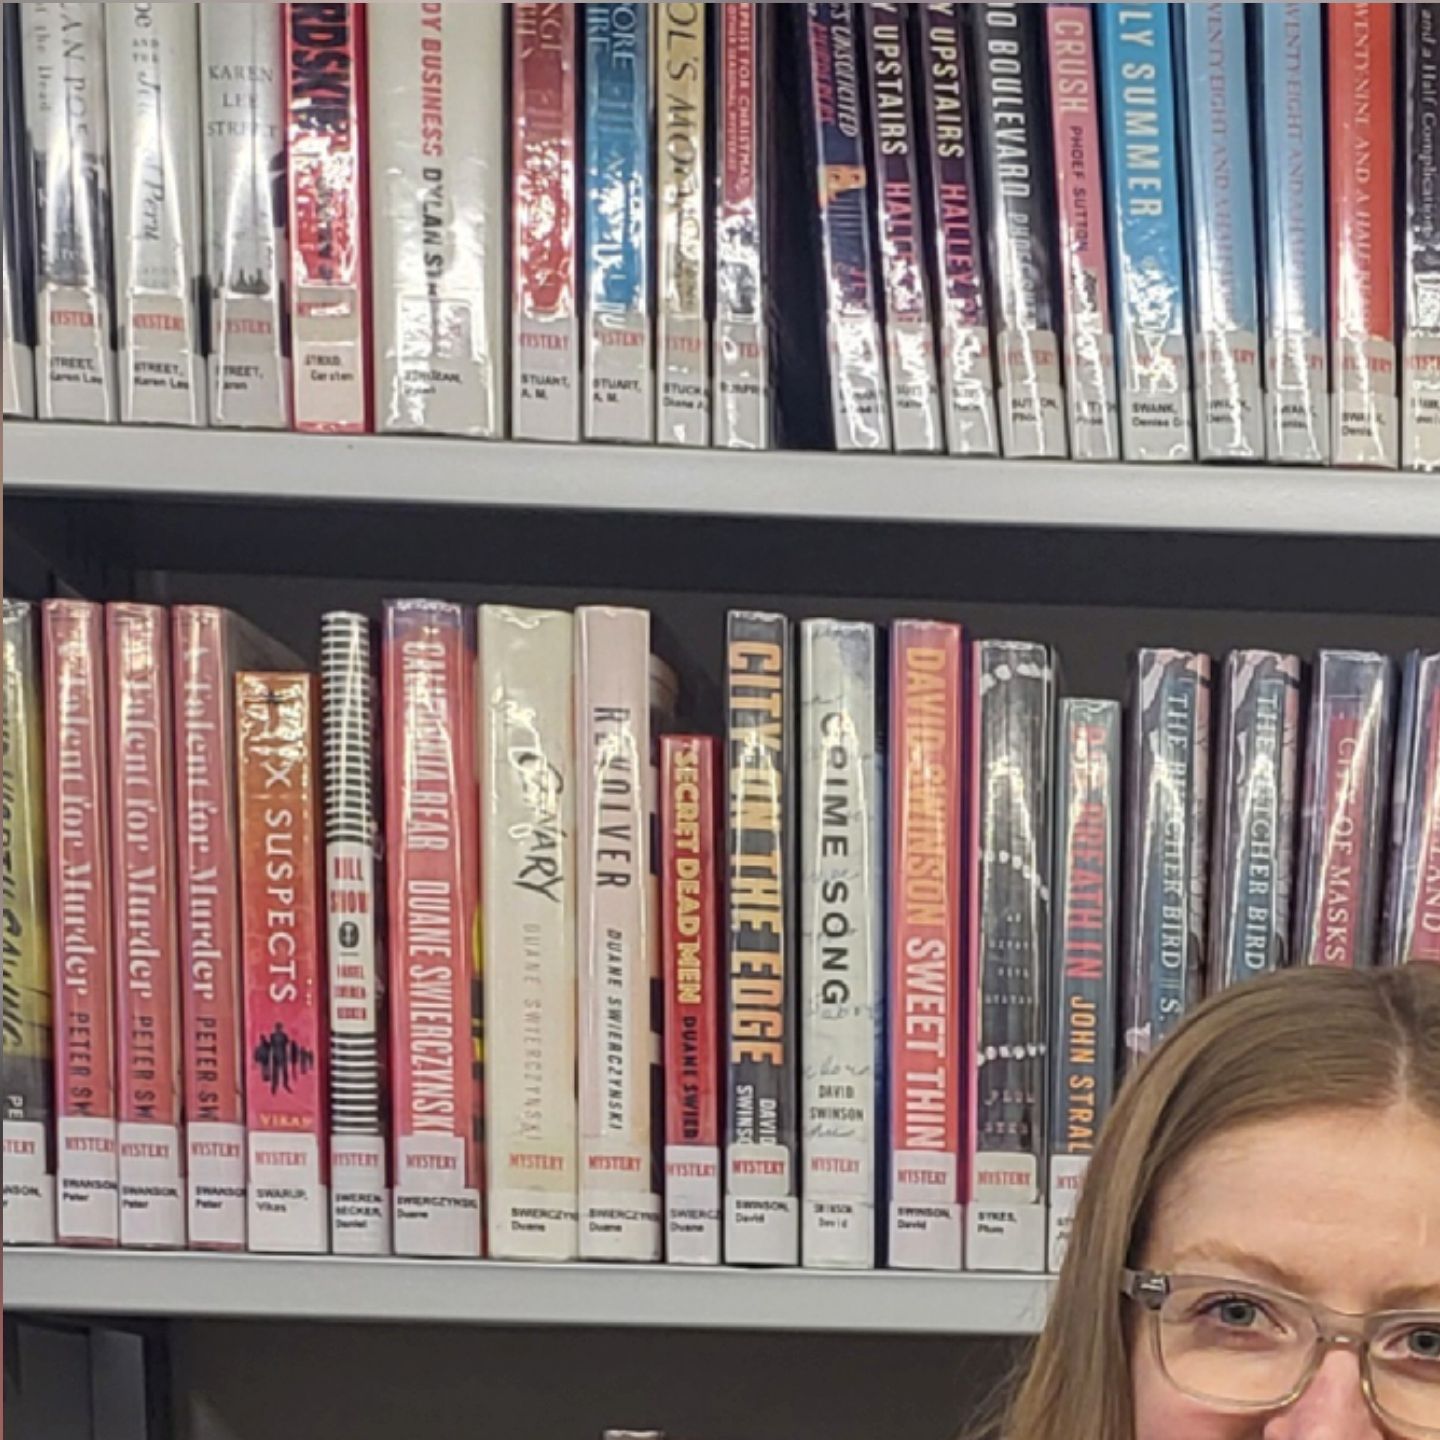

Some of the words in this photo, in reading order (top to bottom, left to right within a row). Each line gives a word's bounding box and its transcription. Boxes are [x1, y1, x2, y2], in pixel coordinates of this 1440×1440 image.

[420, 38, 444, 156] BUSINESS
[873, 24, 907, 156] UPSTAIRS
[930, 25, 965, 157] UPSTAIRS
[1052, 19, 1089, 112] CRUSH
[988, 40, 1031, 197] BOULEVARD
[1122, 63, 1163, 217] SUMMER
[674, 745, 701, 853] SECRET
[66, 862, 98, 996] Murder
[268, 811, 300, 1004] SUSPECTS
[410, 881, 451, 957] DUANE
[675, 860, 702, 936] DEAD
[731, 855, 785, 933] THE
[821, 879, 849, 1006] SONG
[1244, 906, 1266, 970] BIRD
[1323, 862, 1353, 964] MASKS
[607, 928, 624, 990] DUANE
[677, 944, 702, 1004] MEN
[732, 951, 786, 1065] EDGE
[906, 937, 947, 1058] SWEET
[606, 993, 624, 1131] SWIERCZYNSKI
[1070, 993, 1094, 1060] JOHN
[809, 1106, 863, 1121] SWINSON
[818, 1084, 854, 1099] DAVID
[257, 1202, 287, 1213] Vikas
[733, 1158, 786, 1177] MYSTERY
